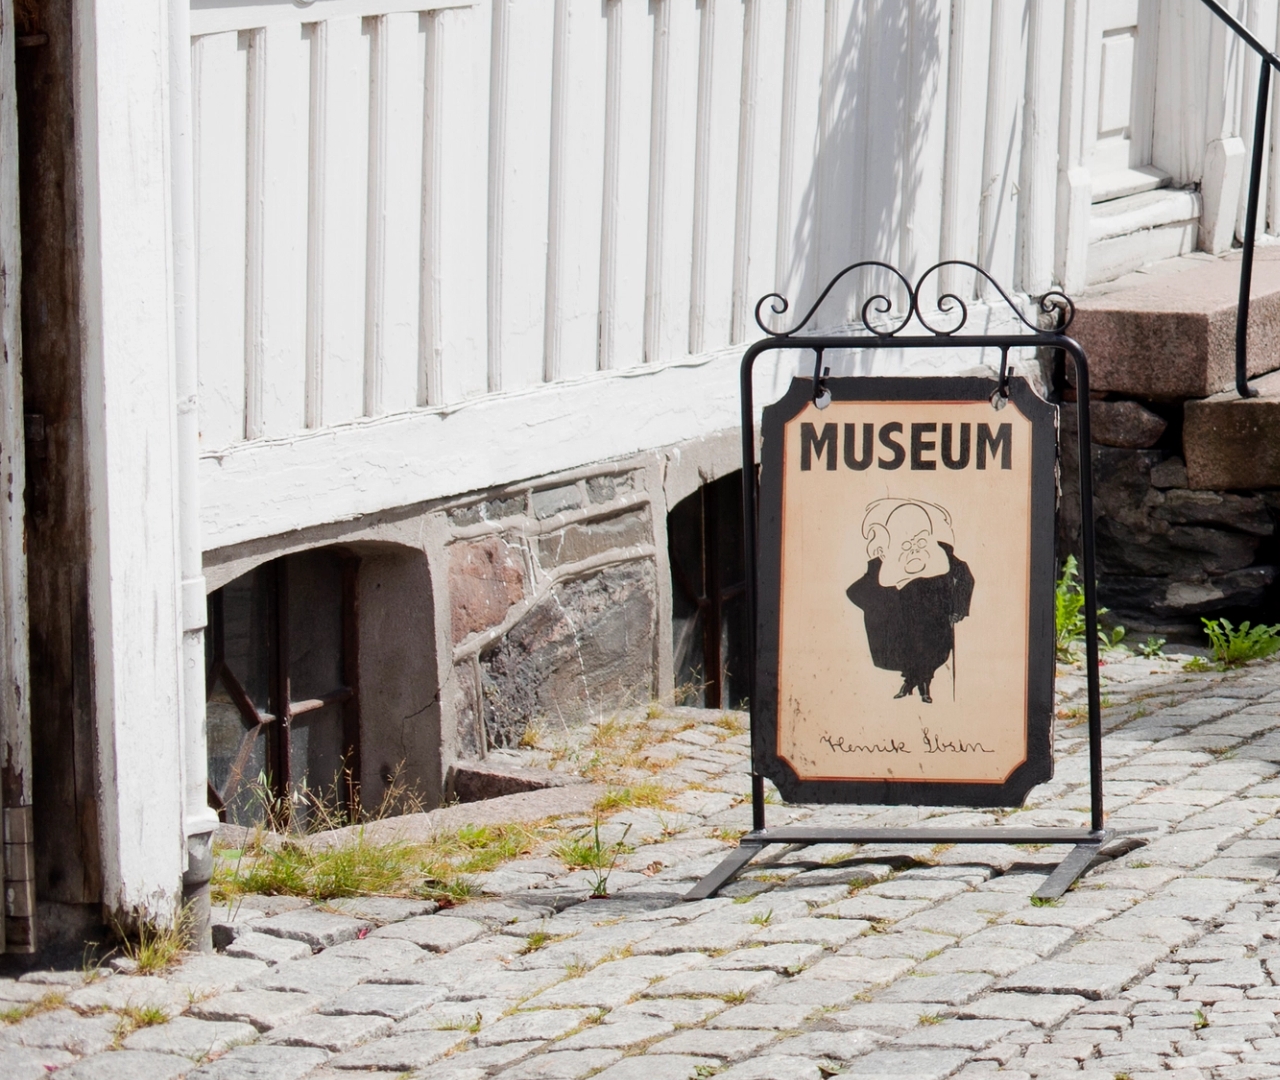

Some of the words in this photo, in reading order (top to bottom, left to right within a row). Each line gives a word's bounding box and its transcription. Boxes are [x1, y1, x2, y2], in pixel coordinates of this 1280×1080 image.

[801, 422, 1012, 471] MUSEUM
[820, 735, 911, 754] Henrik
[923, 726, 995, 754] Ibsen
